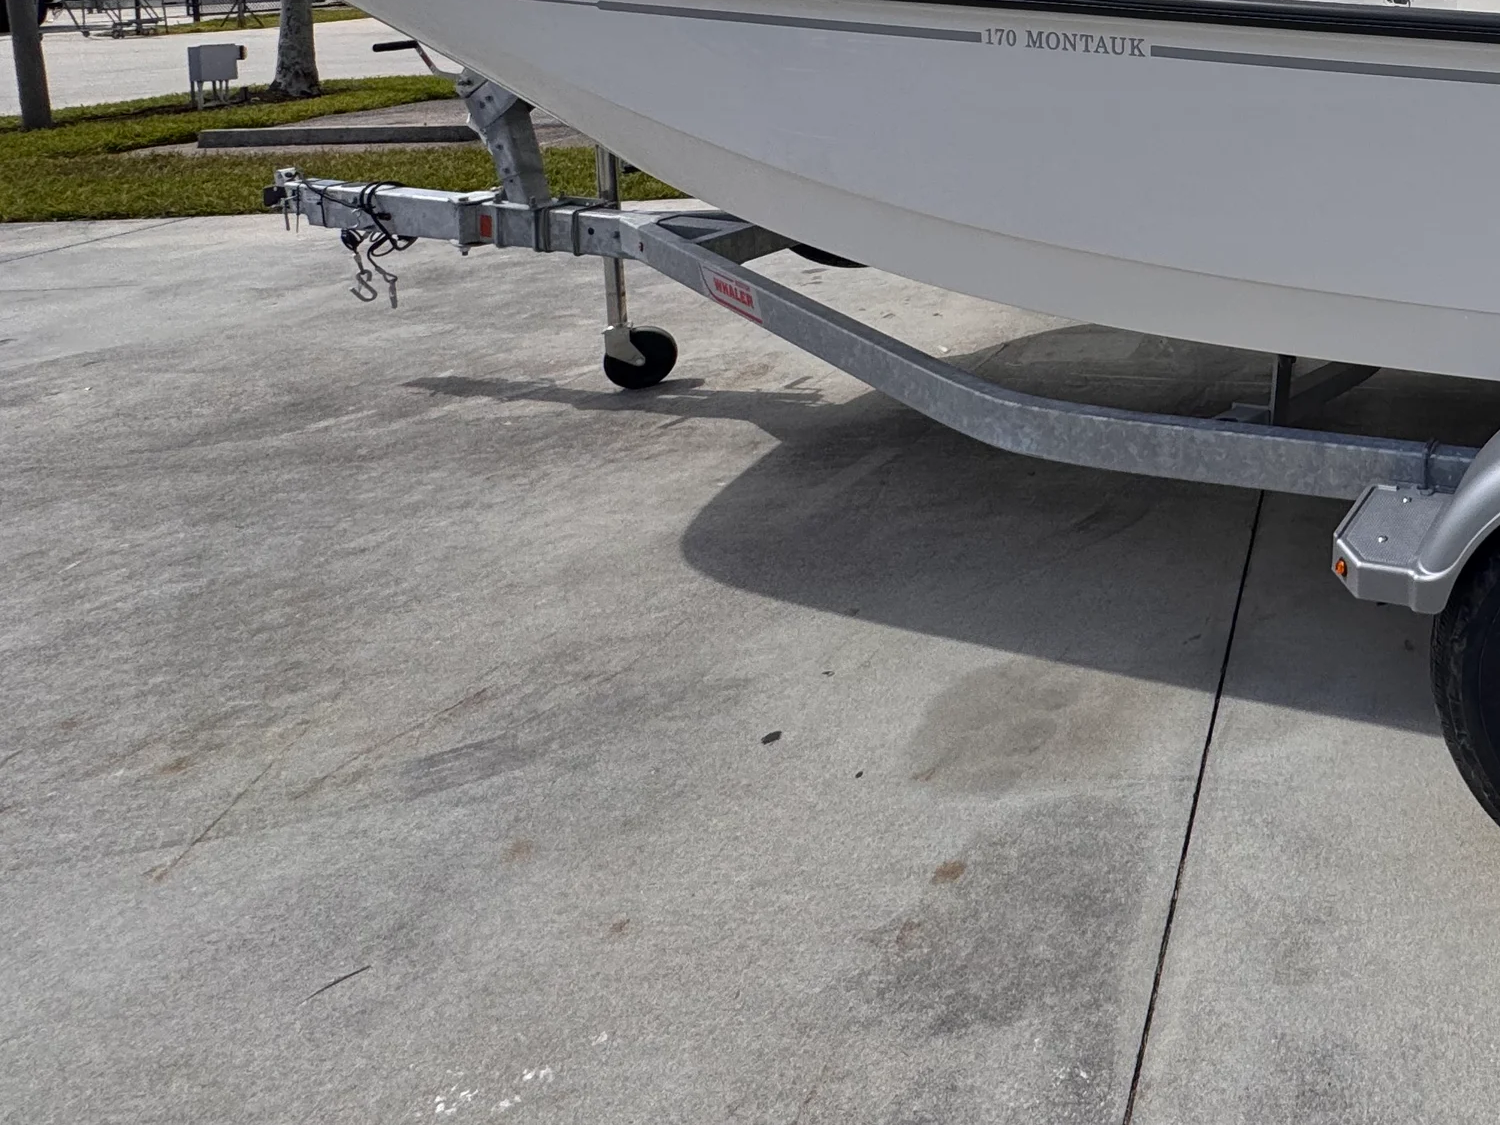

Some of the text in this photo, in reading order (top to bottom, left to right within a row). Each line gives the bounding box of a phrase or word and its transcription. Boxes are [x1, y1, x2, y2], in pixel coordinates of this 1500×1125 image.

[985, 28, 1146, 57] 170 MONTAUK
[713, 277, 754, 310] WHALER
